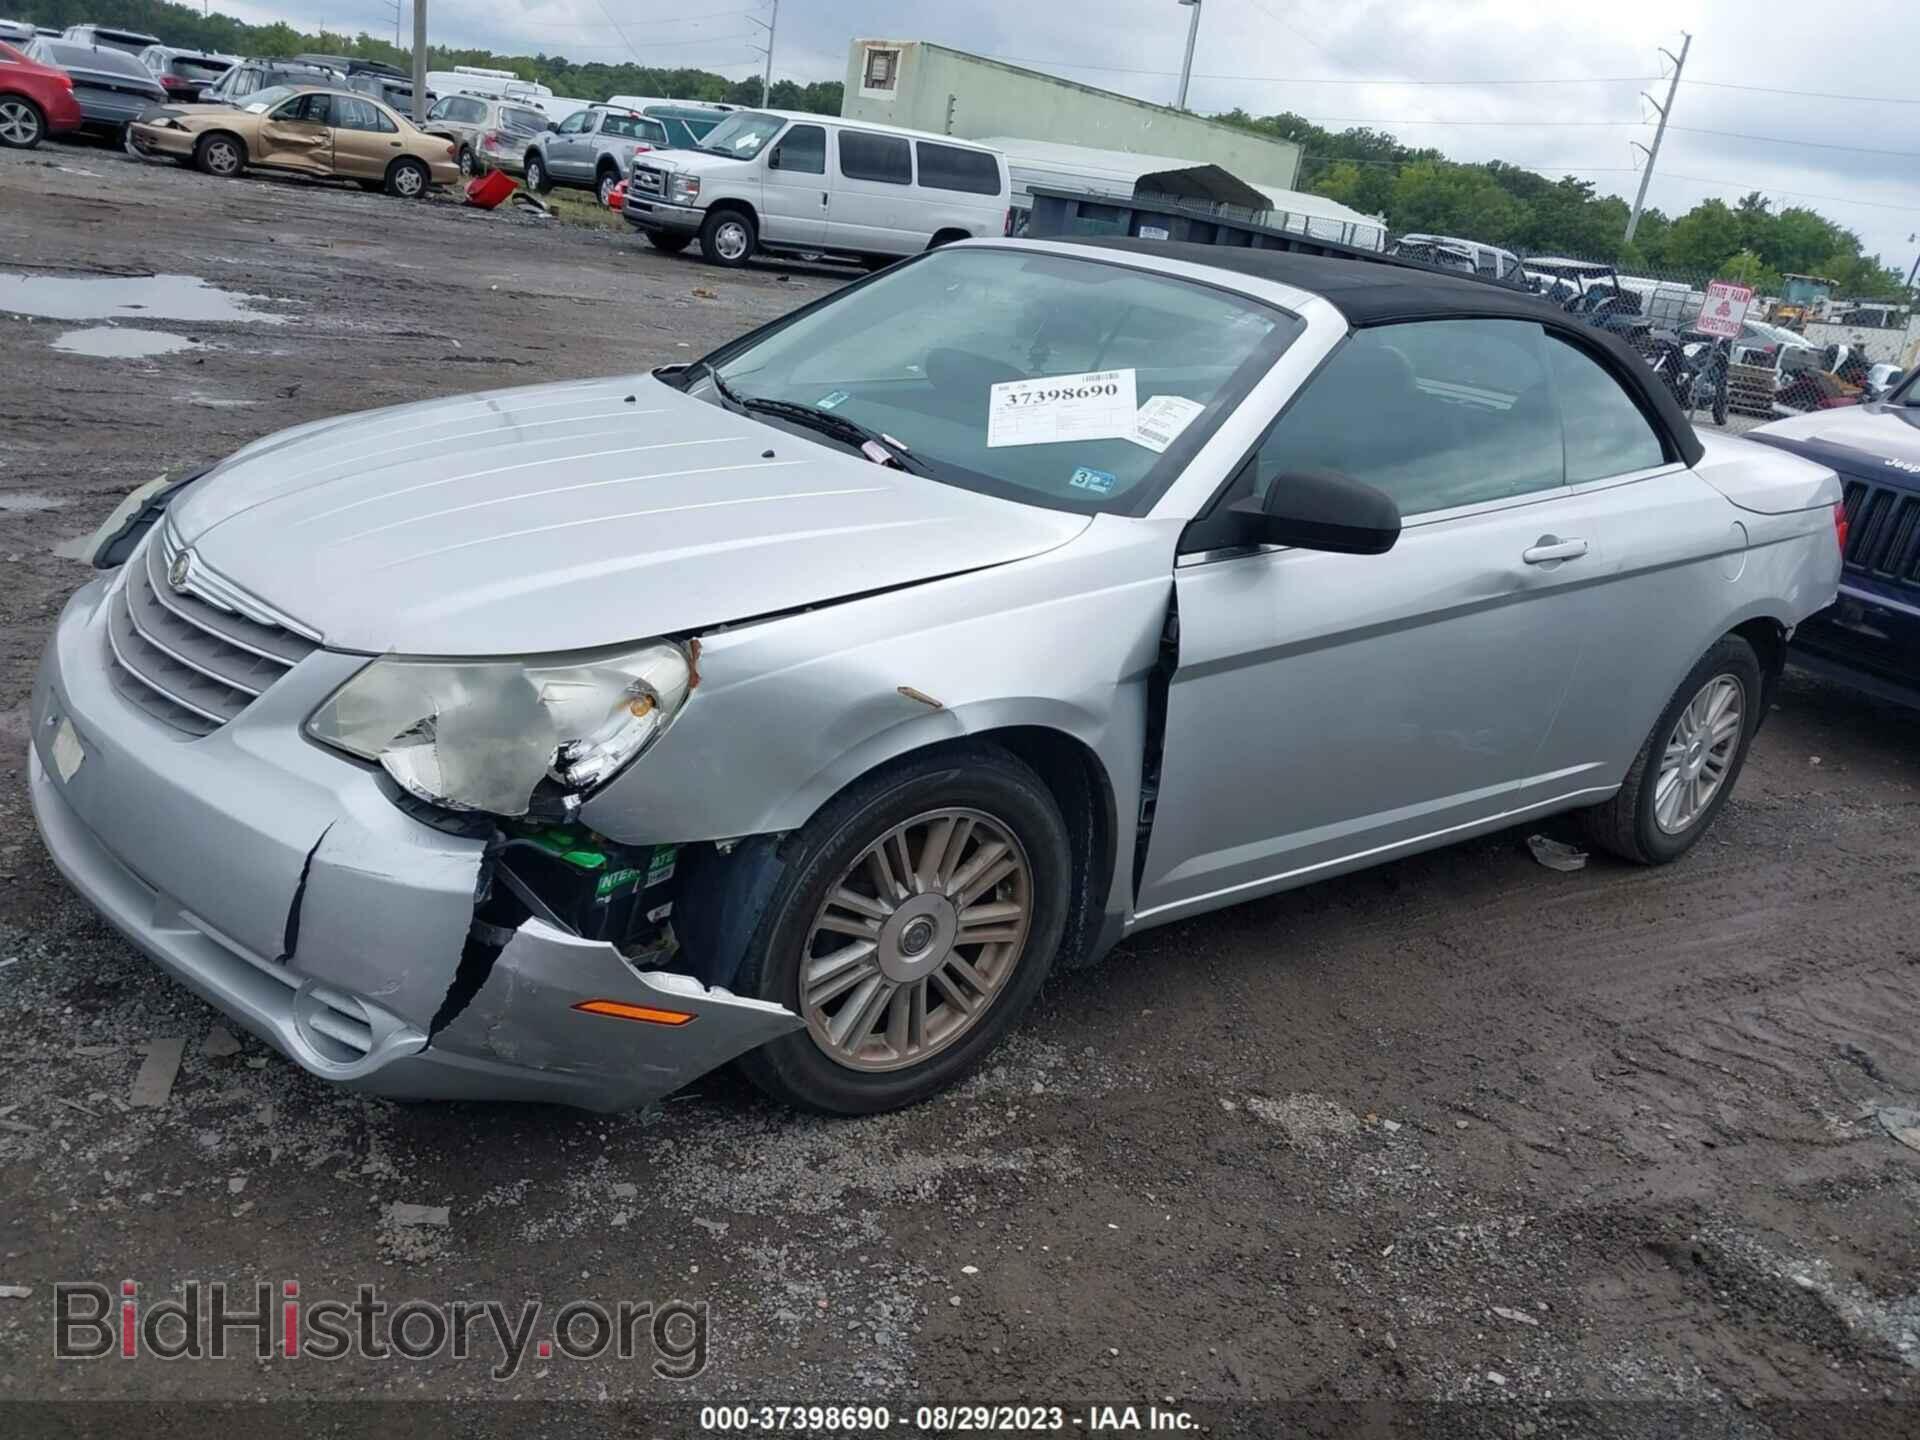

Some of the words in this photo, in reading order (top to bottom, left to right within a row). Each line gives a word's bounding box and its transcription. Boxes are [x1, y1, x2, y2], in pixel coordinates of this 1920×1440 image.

[1005, 383, 1119, 407] 37398690
[1884, 458, 1920, 474] Jeep
[1074, 471, 1088, 484] 3
